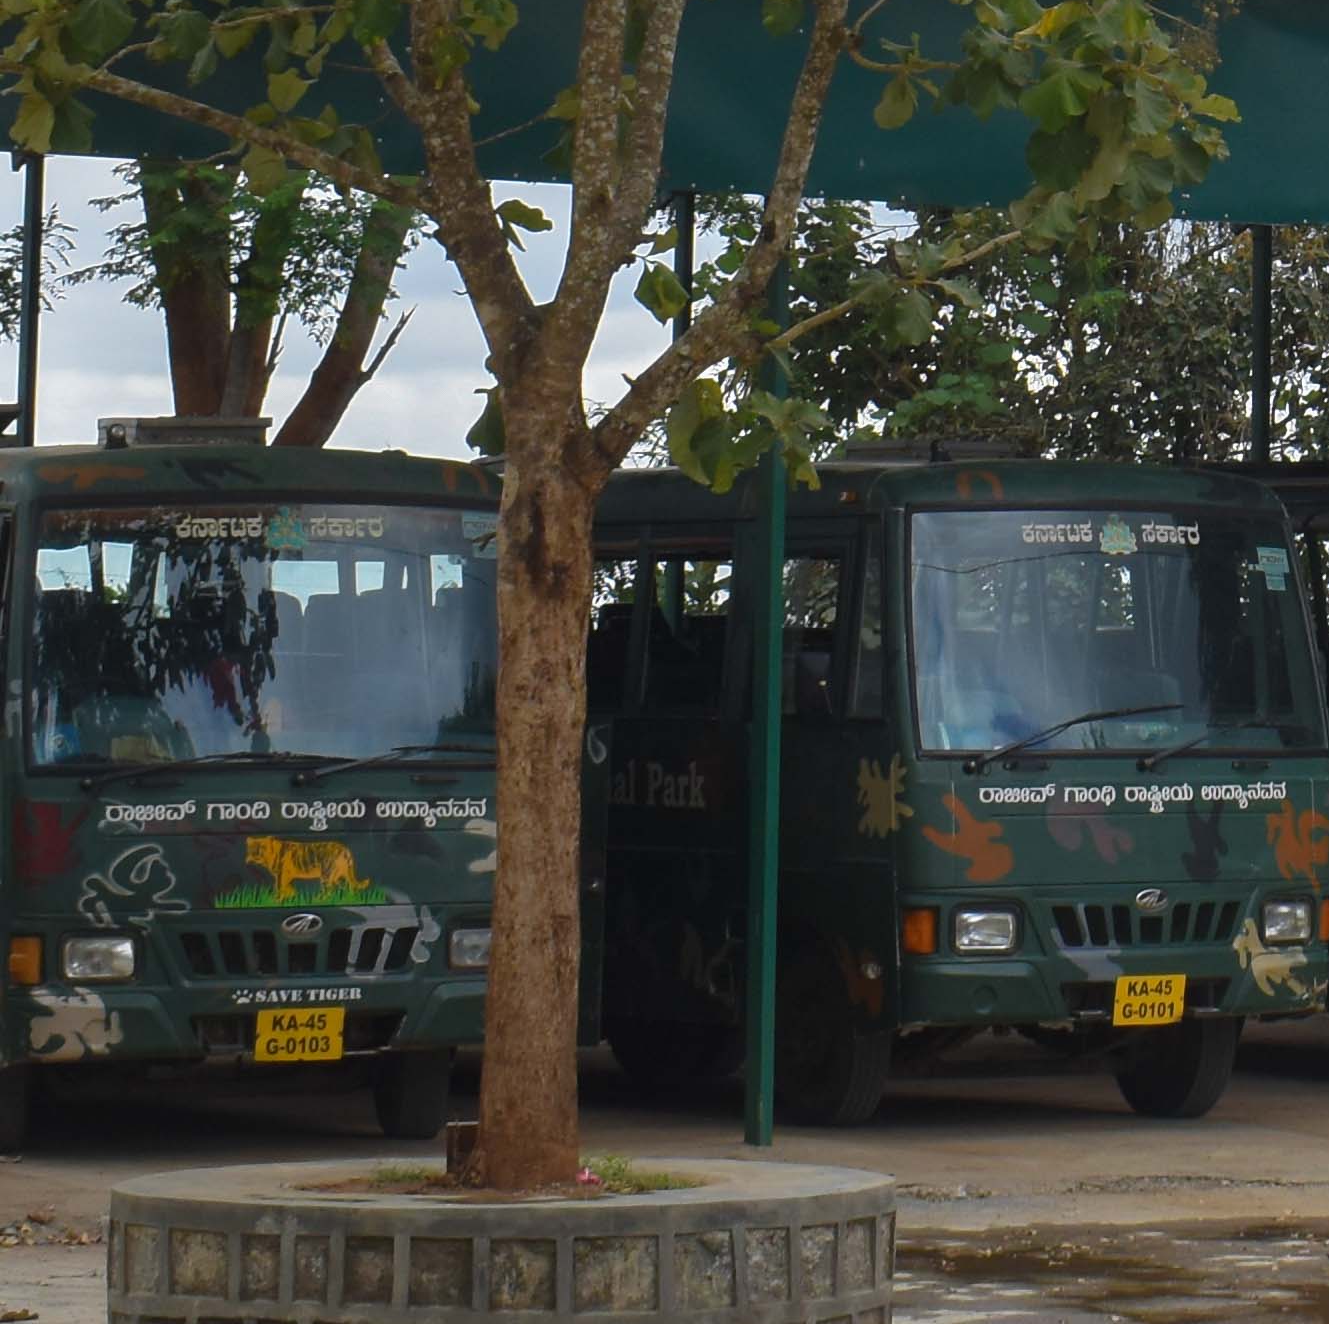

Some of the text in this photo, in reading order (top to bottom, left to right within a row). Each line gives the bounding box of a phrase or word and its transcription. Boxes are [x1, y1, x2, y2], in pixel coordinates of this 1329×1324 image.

[647, 760, 706, 810] Park
[255, 987, 362, 1003] SAVE TIGER
[1127, 979, 1173, 996] KA-45
[1122, 1002, 1175, 1019] G-0101
[271, 1014, 327, 1032] KA-45
[265, 1036, 331, 1055] G-0103
